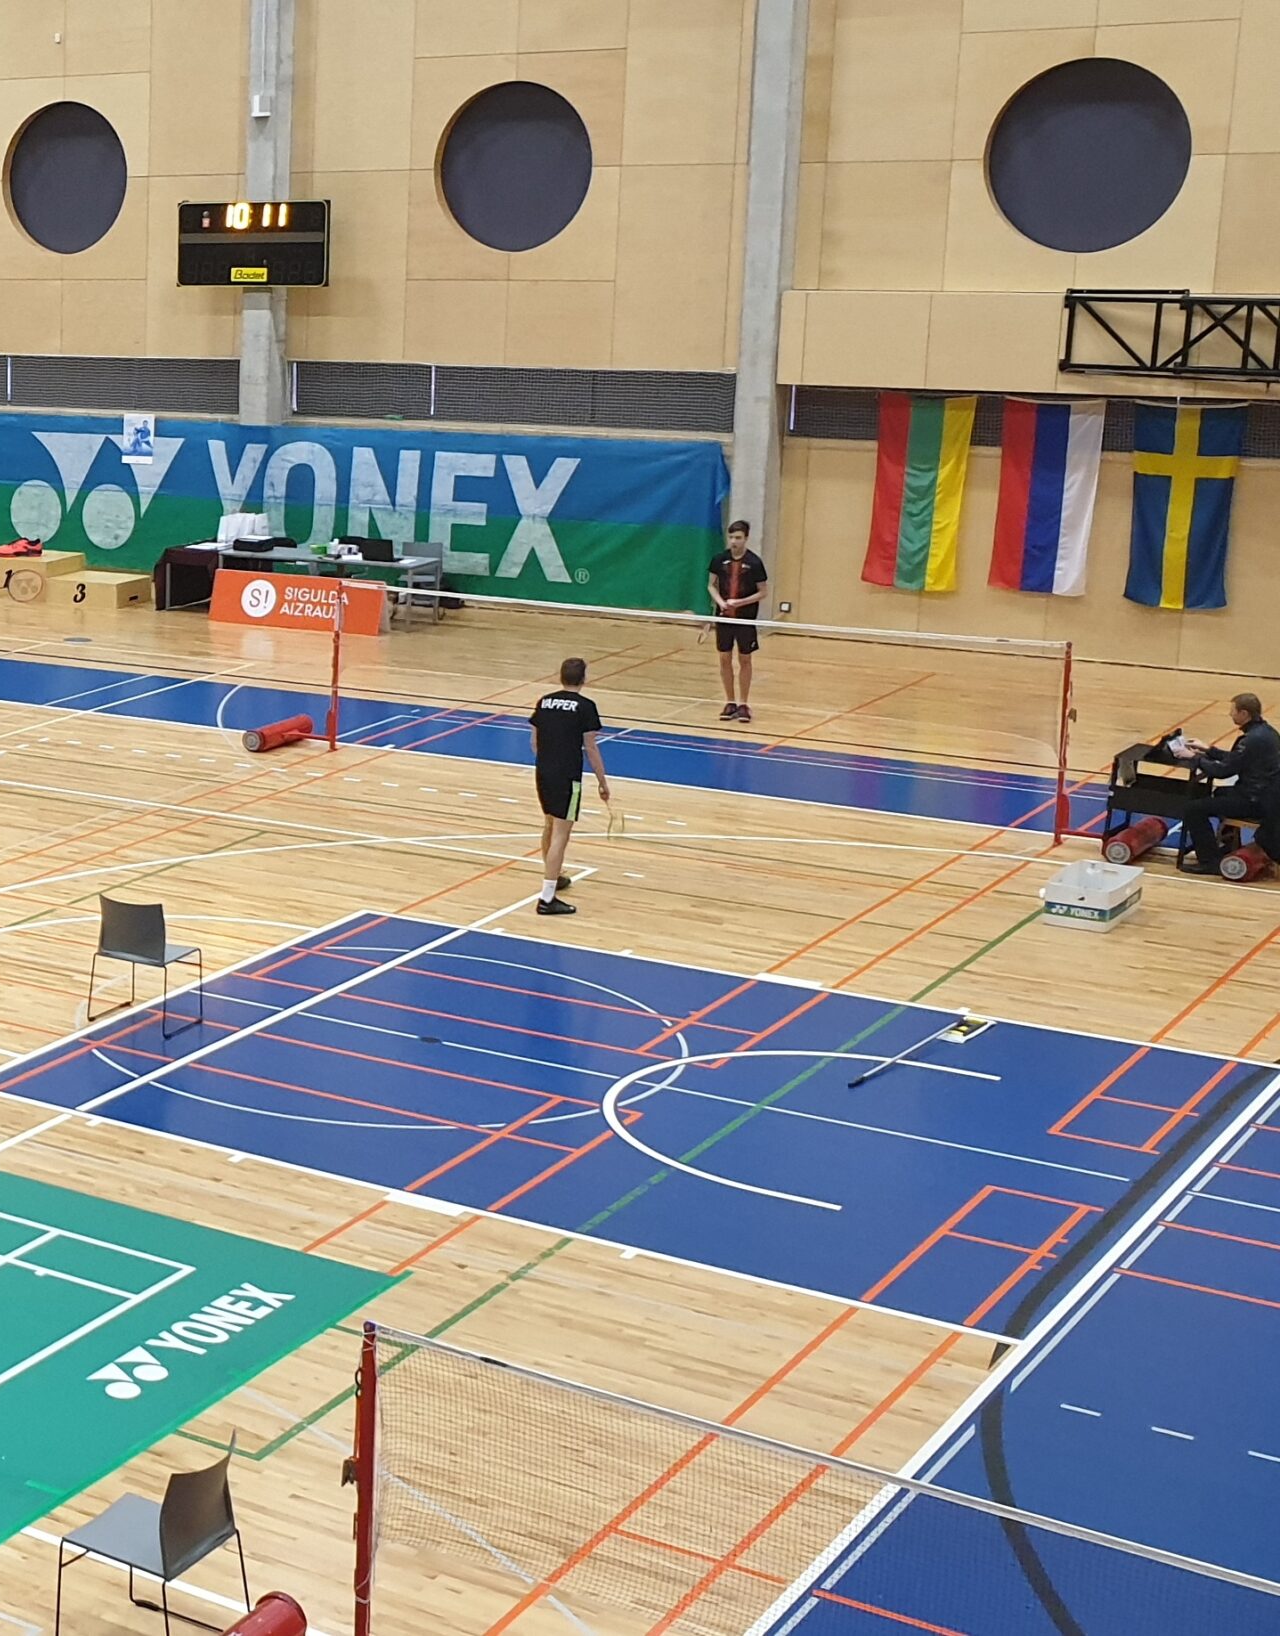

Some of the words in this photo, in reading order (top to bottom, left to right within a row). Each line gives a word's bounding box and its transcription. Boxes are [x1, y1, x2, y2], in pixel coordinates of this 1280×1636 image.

[207, 439, 581, 583] YONEX
[3, 569, 13, 588] 1
[73, 583, 87, 603] 3
[144, 1282, 296, 1355] YONEX
